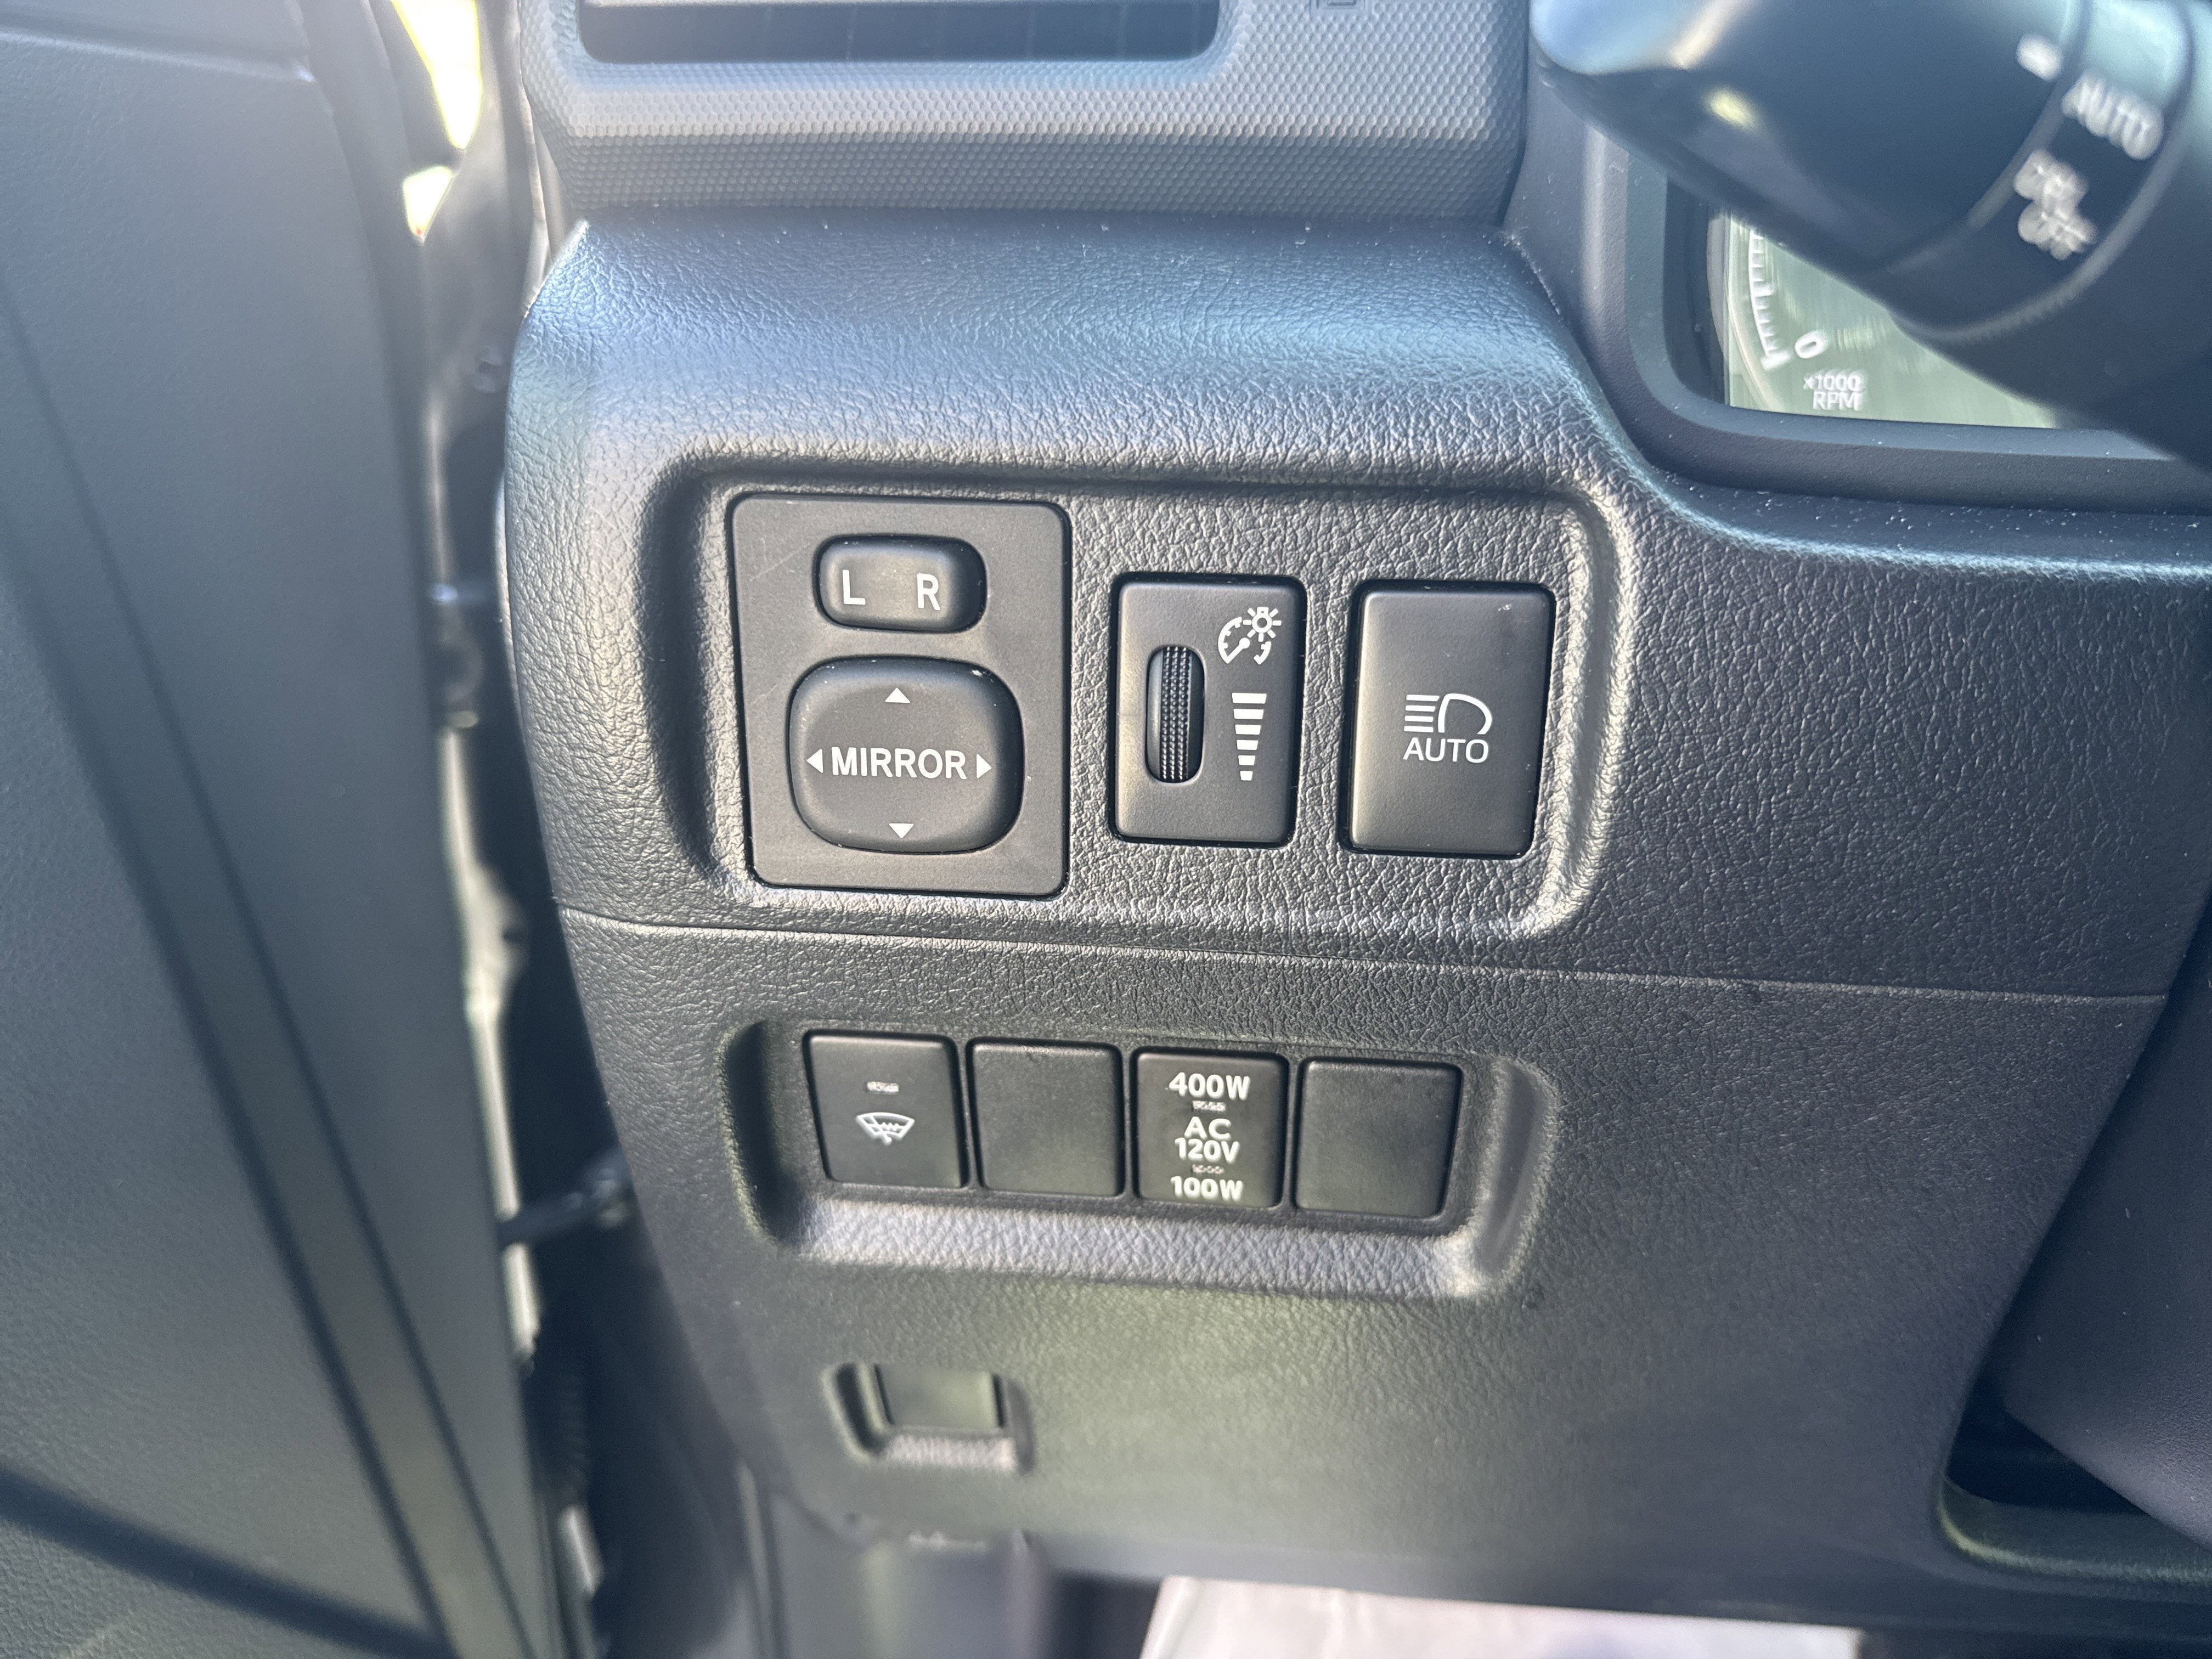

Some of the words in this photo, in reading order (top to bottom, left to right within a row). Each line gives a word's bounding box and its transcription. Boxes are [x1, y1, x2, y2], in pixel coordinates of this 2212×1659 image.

[2061, 71, 2164, 160] AUTO
[1813, 391, 1864, 411] RPM
[842, 569, 866, 605] L
[917, 573, 940, 611] R
[832, 747, 967, 780] MIRROR
[1403, 737, 1488, 763] AUTO
[1169, 1072, 1250, 1100] 400W
[1184, 1116, 1231, 1140] AC
[1175, 1137, 1239, 1164] 120V
[1170, 1176, 1243, 1201] 100W
